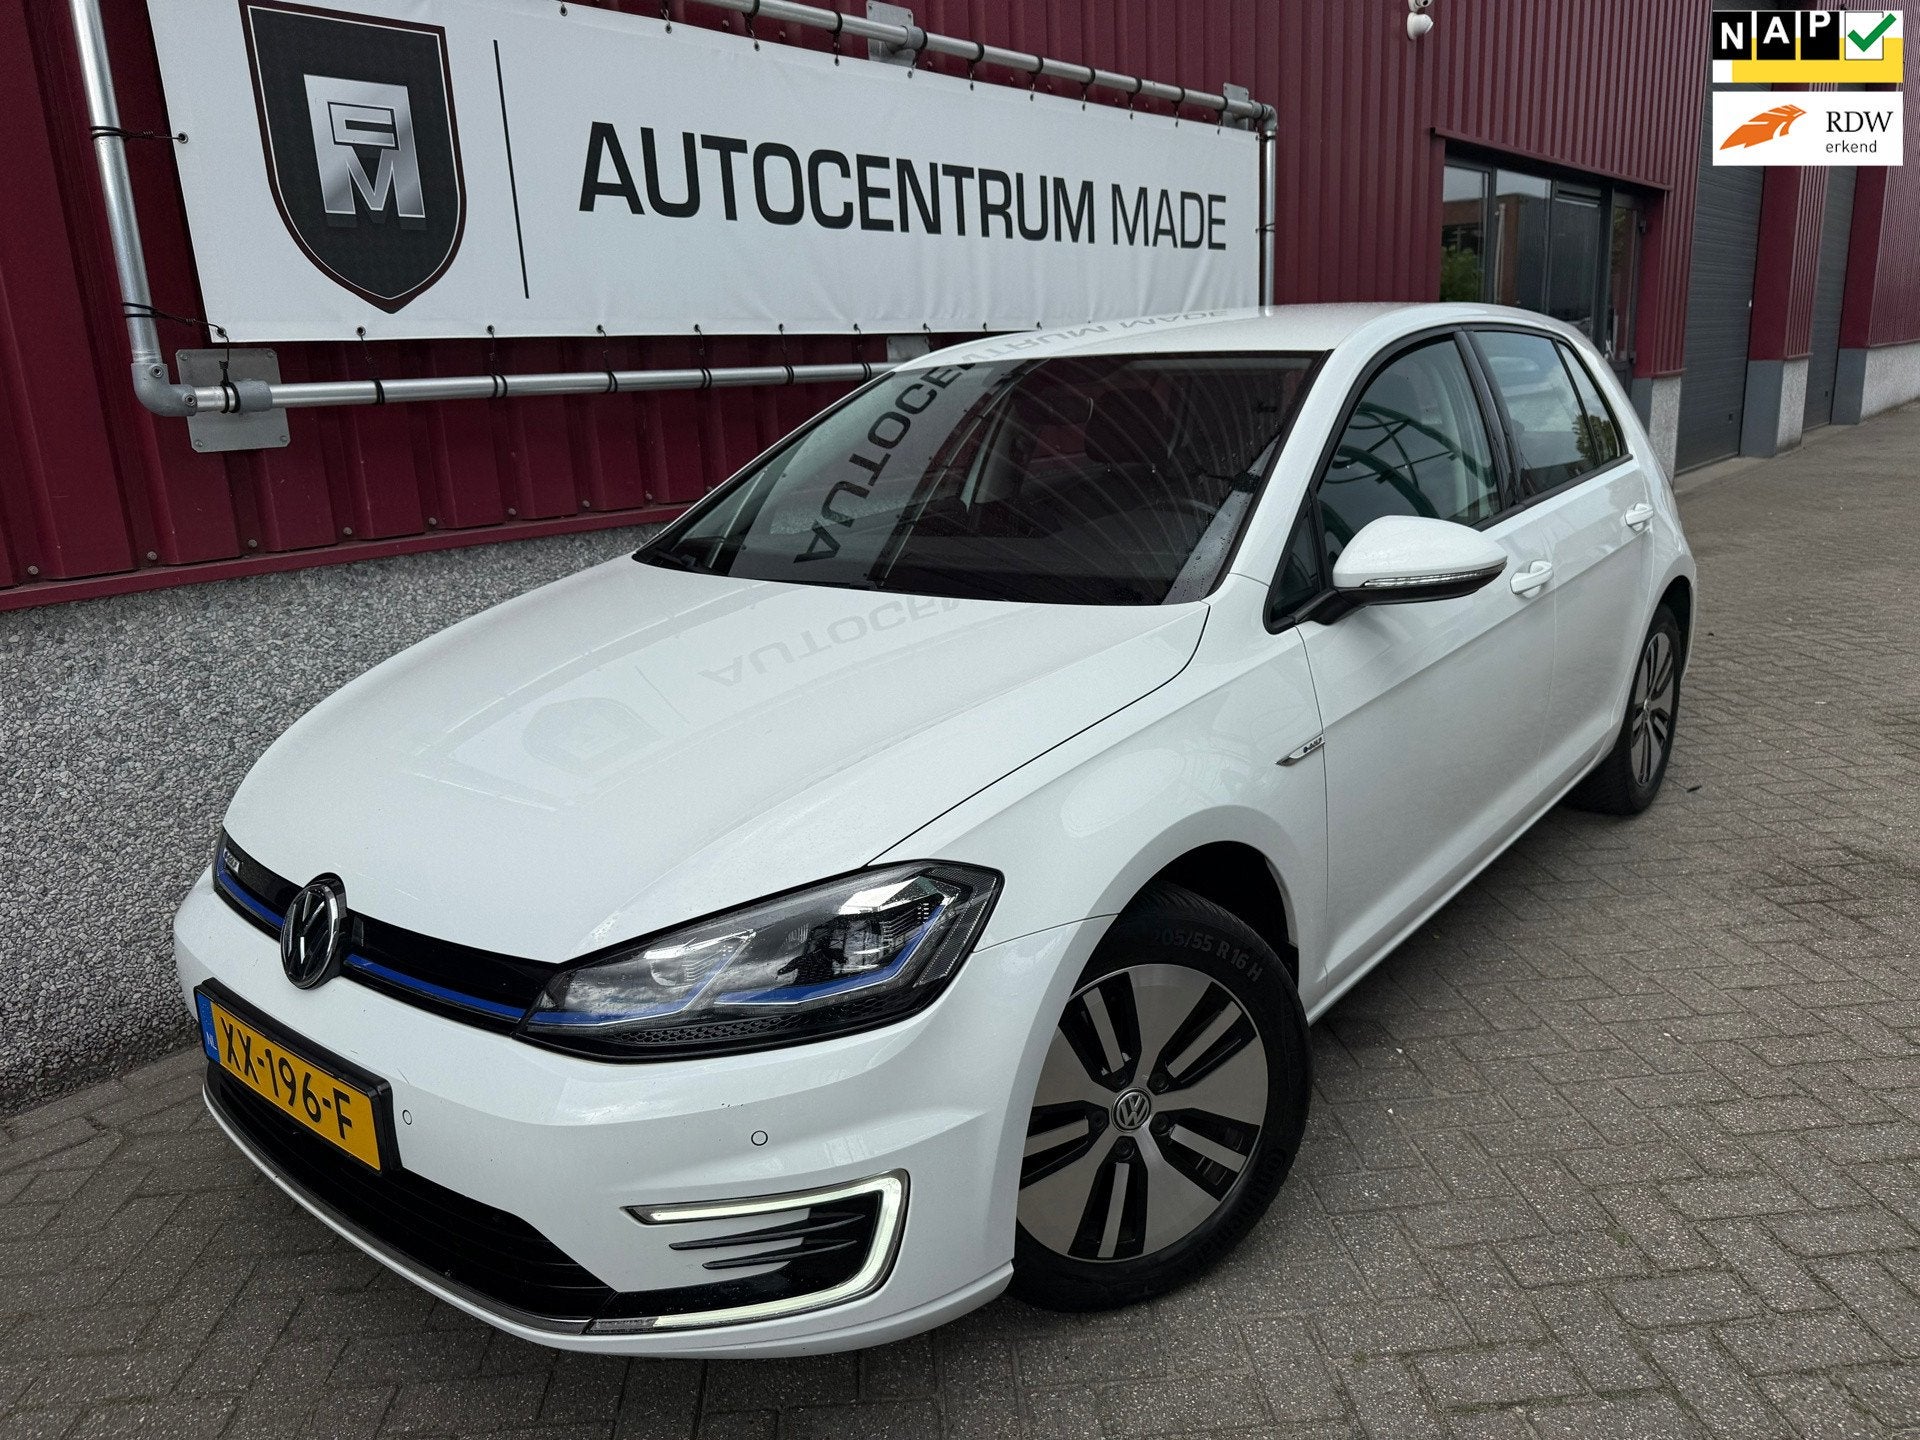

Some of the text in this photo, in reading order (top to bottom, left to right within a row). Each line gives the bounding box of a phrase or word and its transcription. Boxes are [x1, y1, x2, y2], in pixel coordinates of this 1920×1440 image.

[579, 121, 1226, 251] AUTOCENTRUM MADE
[1216, 940, 1231, 959] R
[1231, 949, 1250, 969] 16
[1246, 962, 1263, 982] H
[221, 1017, 352, 1140] XX-196-F
